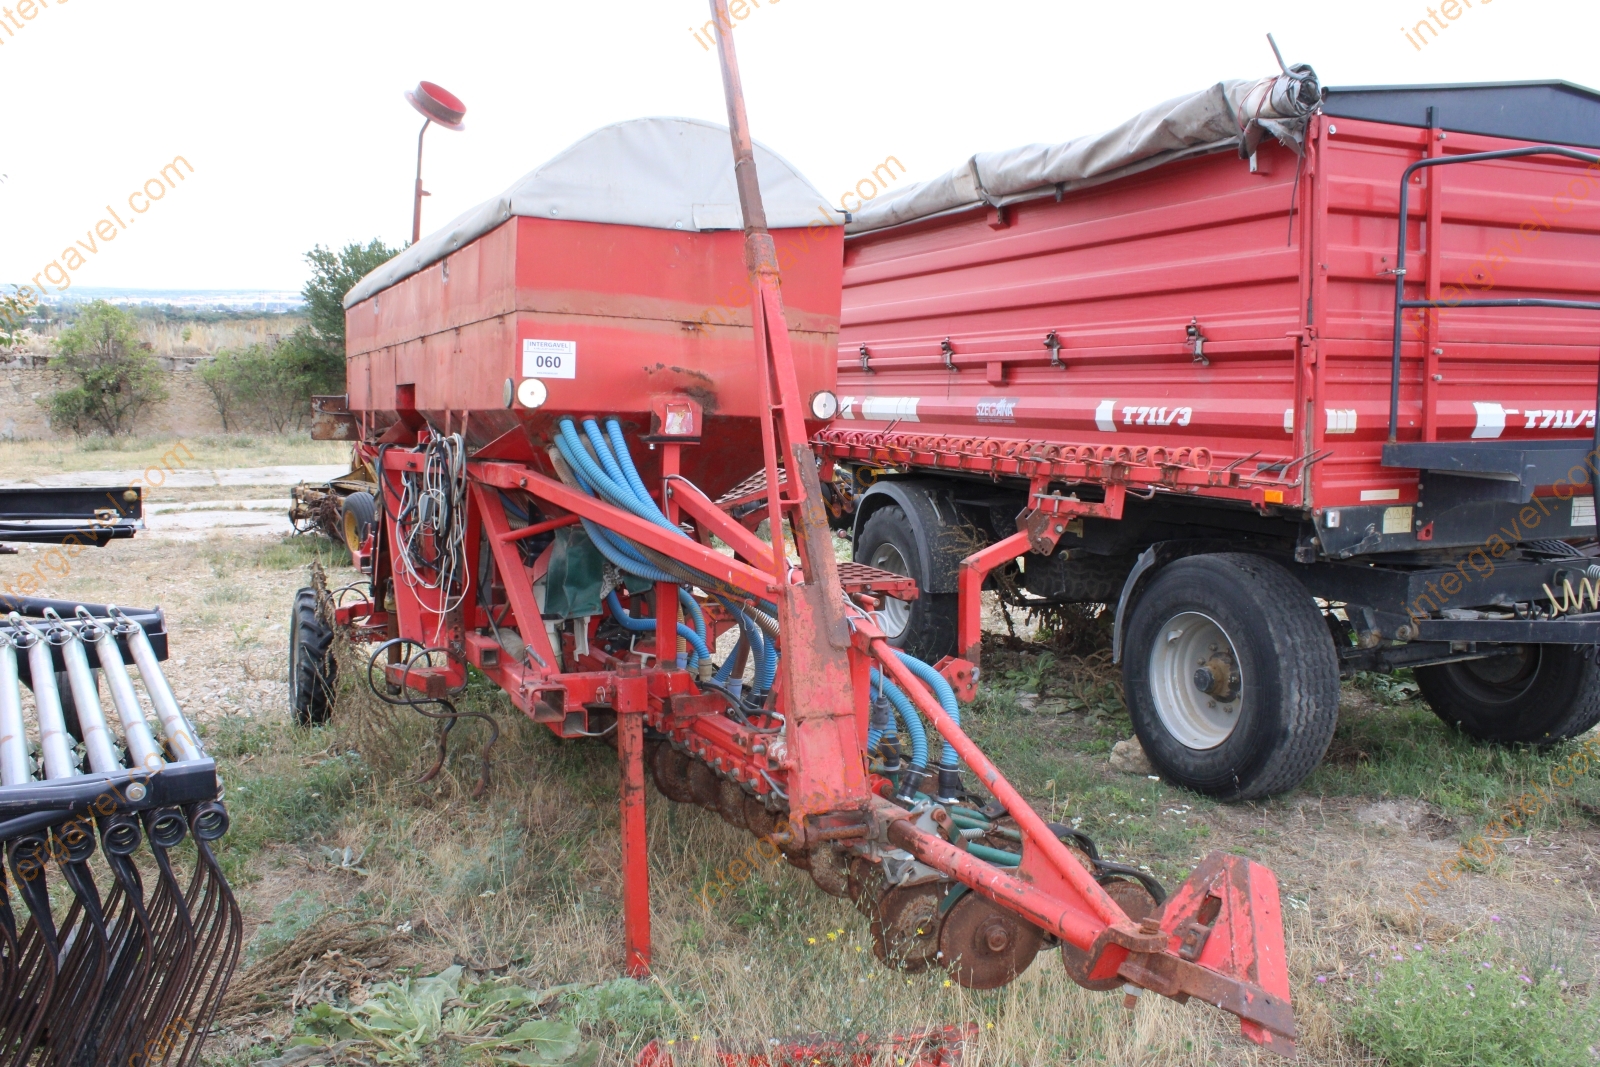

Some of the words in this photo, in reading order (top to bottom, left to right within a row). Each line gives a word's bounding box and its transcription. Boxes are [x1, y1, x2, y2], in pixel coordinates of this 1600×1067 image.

[529, 341, 568, 349] INTERGAVEL
[536, 355, 561, 368] 060
[1122, 406, 1192, 426] T711/3
